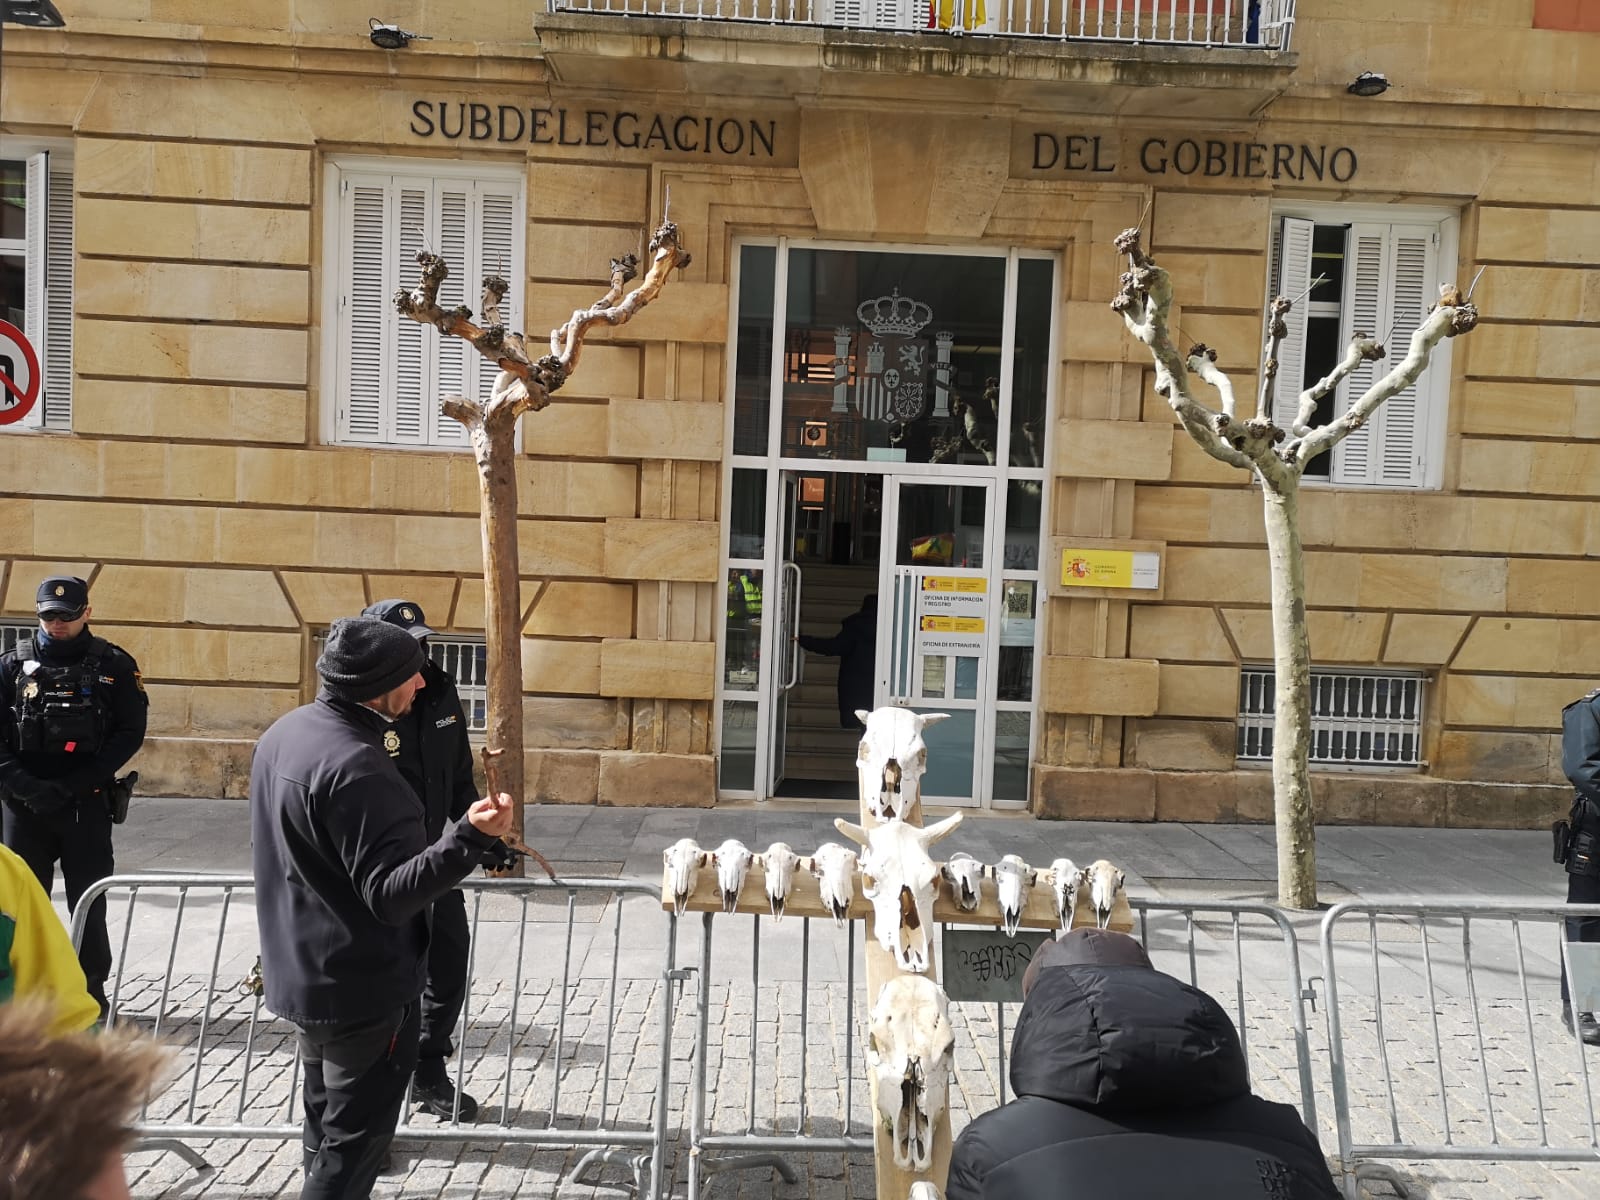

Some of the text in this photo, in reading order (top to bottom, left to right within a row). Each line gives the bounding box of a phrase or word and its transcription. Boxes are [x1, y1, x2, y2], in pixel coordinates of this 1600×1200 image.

[409, 100, 776, 157] SUBDELEGACION
[1032, 133, 1357, 183] DEL GOBIERNO
